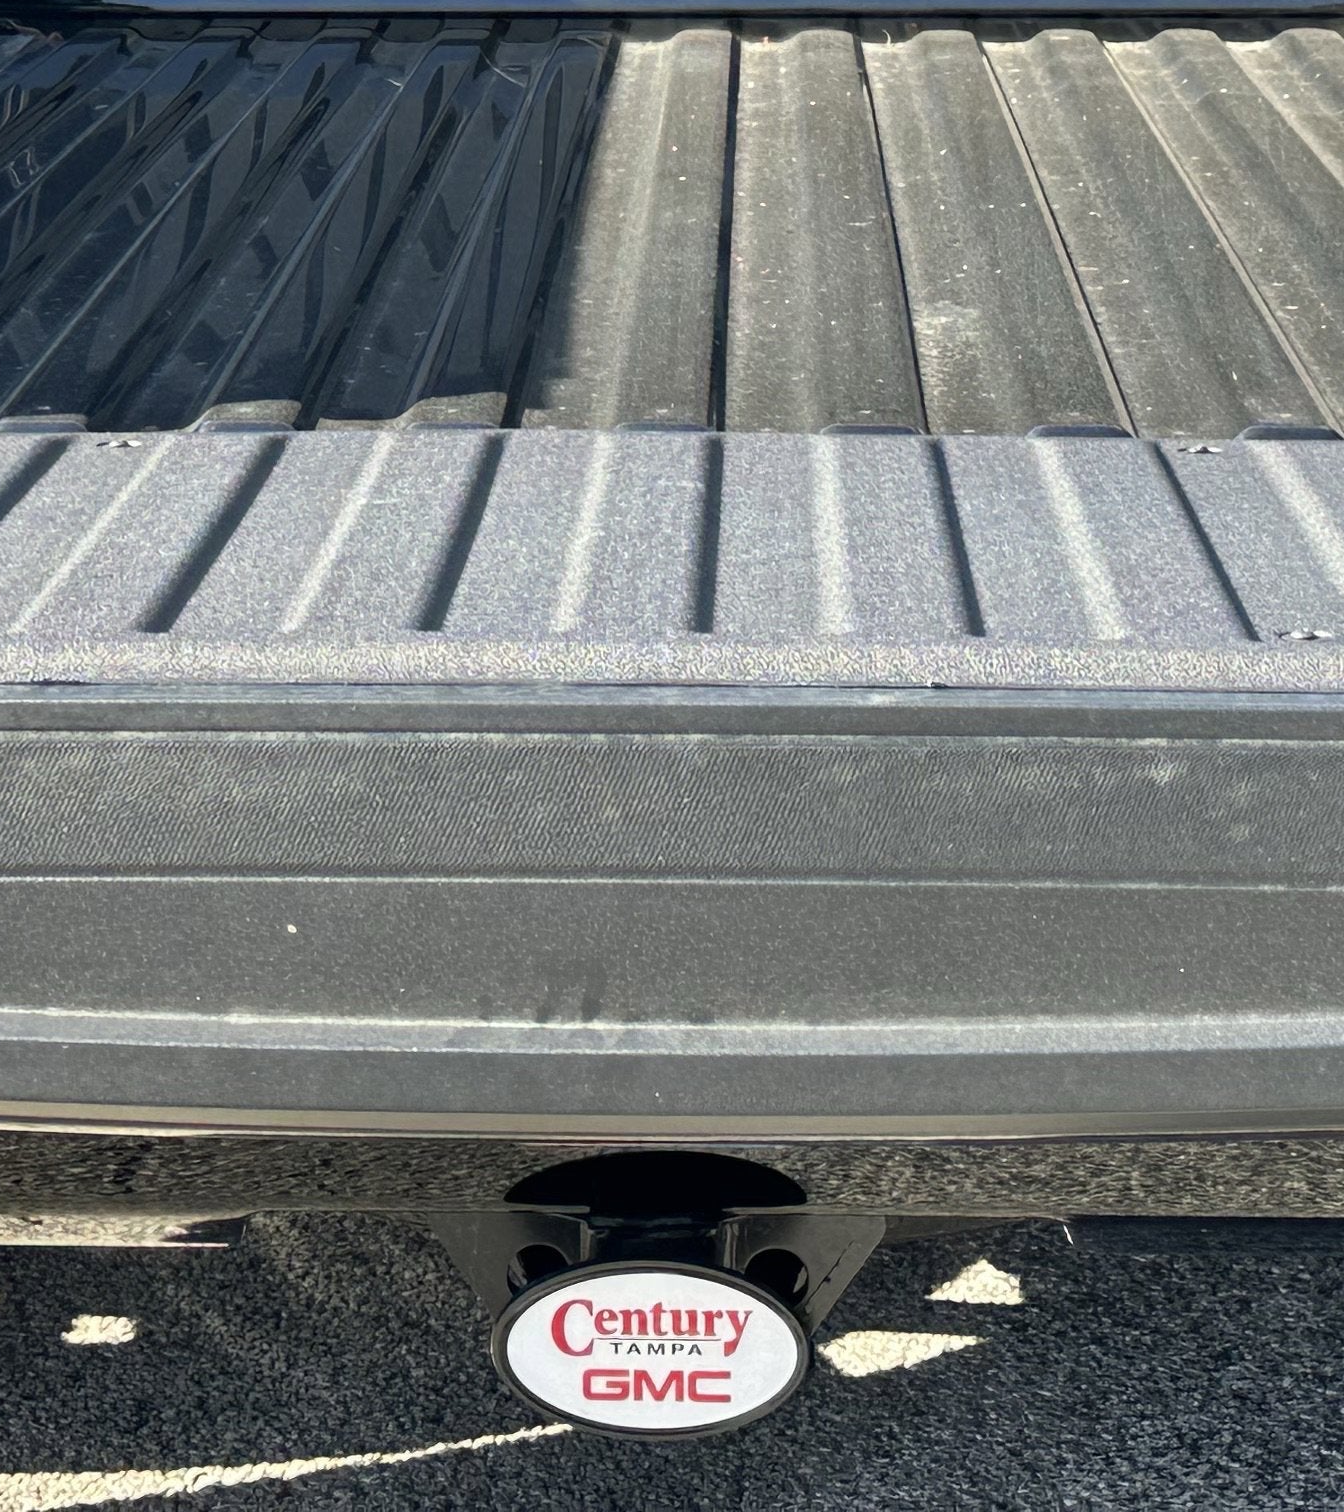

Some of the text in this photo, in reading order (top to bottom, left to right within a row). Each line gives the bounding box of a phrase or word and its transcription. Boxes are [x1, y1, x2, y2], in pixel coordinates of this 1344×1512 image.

[550, 1299, 753, 1357] Century
[610, 1342, 703, 1356] TAMPA
[582, 1369, 732, 1403] GMC
